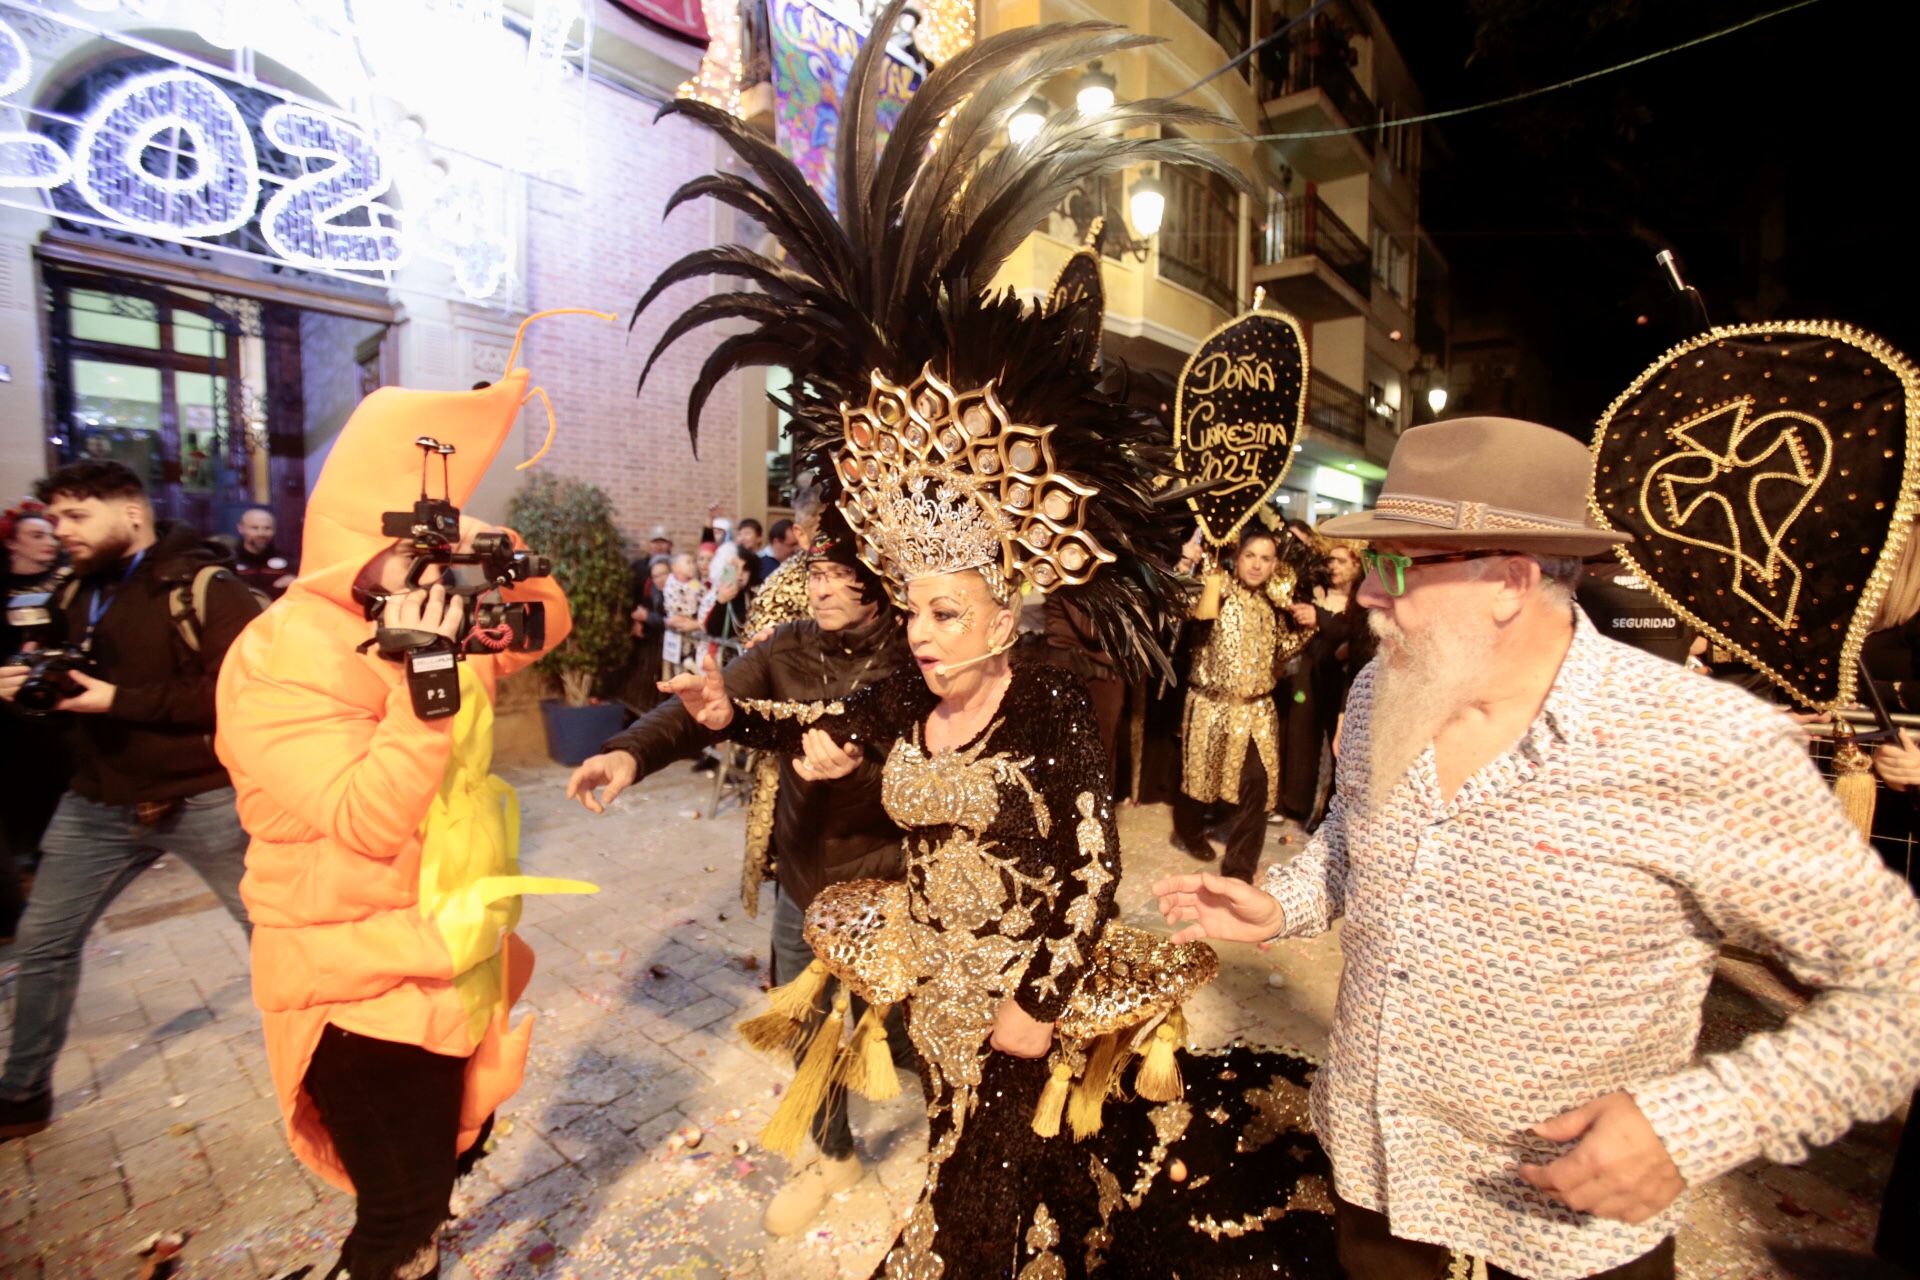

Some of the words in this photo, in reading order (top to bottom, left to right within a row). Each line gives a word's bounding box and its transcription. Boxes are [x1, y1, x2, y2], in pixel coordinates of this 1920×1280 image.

[1191, 451, 1262, 484] 2024
[1612, 617, 1677, 629] SEGURIDAD
[437, 688, 447, 699] 2
